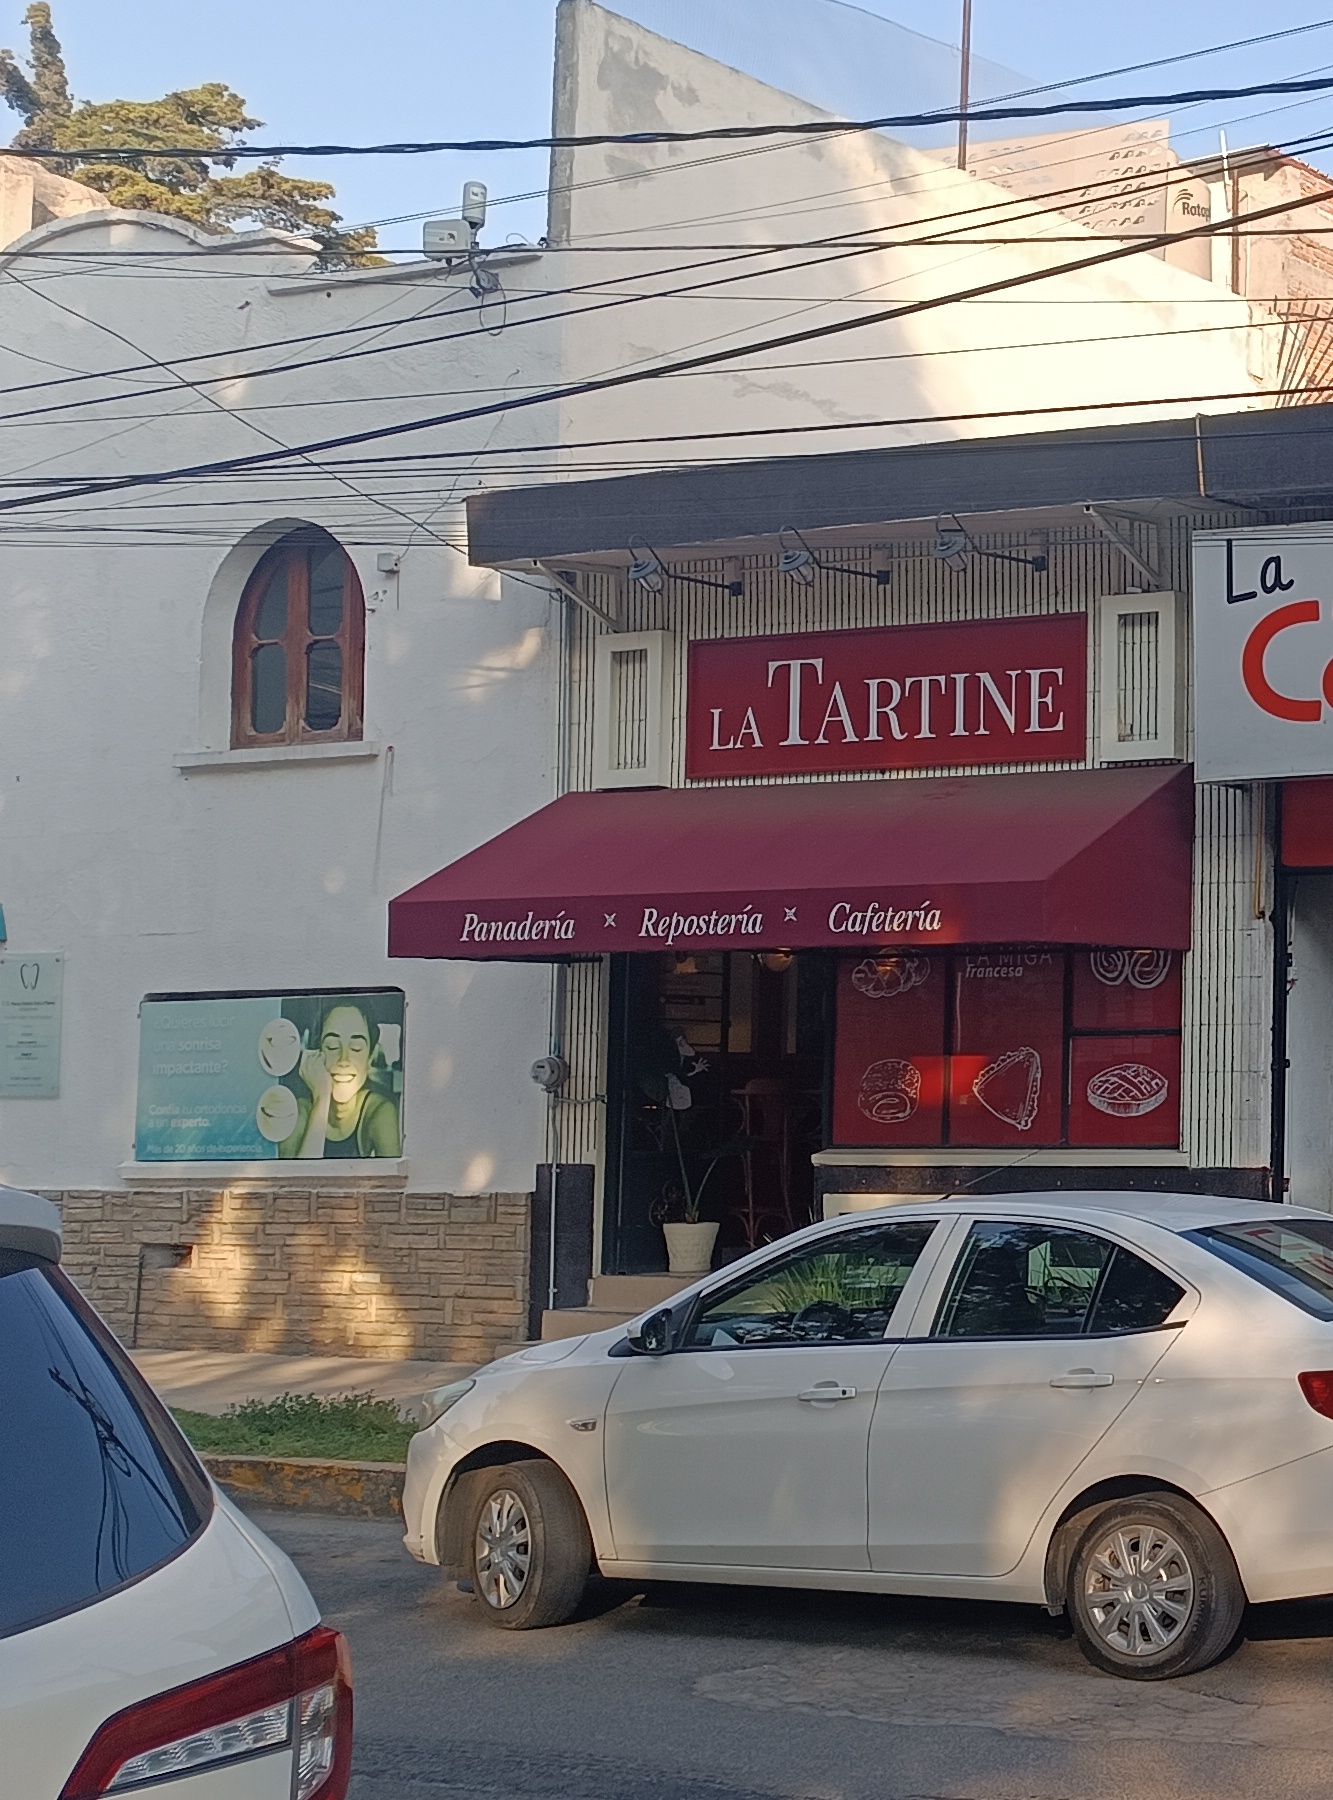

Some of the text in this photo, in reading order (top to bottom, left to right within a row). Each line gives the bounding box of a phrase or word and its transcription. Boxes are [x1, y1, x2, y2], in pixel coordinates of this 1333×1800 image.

[1226, 539, 1295, 604] La
[709, 657, 1065, 751] LA TARTINE
[459, 900, 942, 945] Panadería Repostería Cafetería
[177, 1037, 222, 1052] sonrisa
[151, 1059, 229, 1078] impactante?
